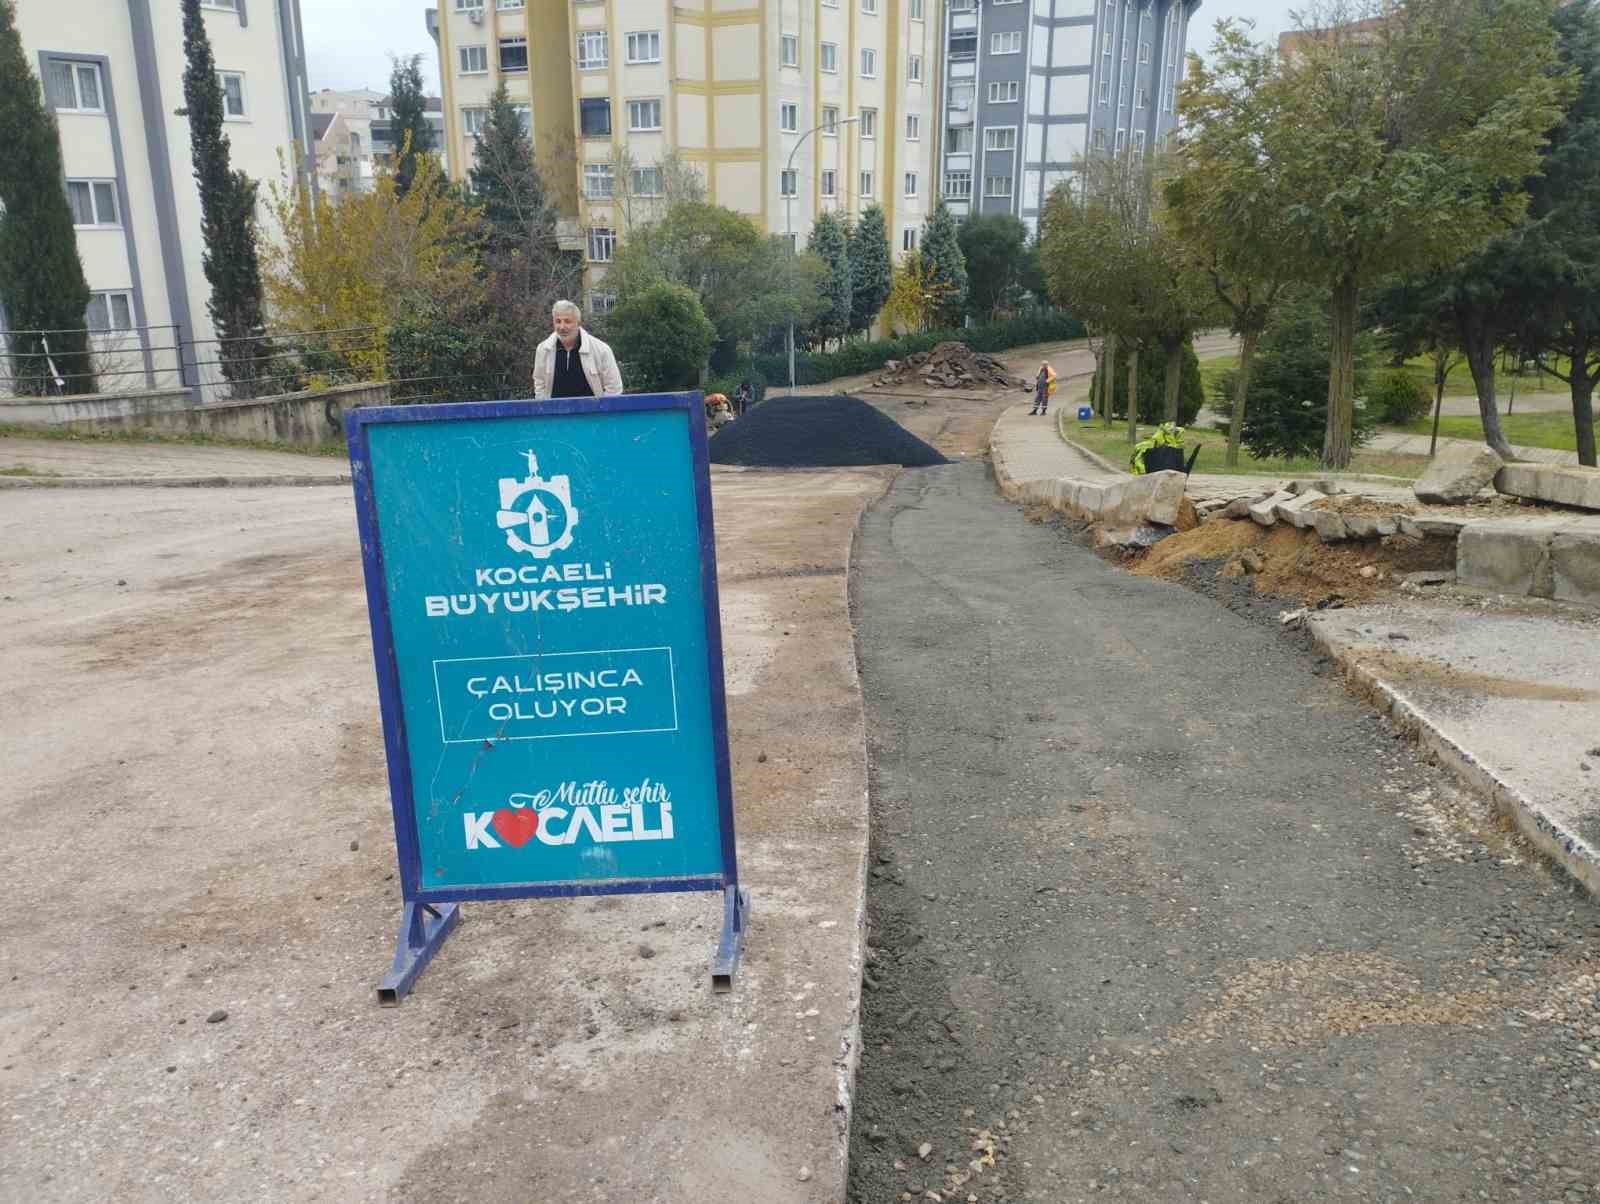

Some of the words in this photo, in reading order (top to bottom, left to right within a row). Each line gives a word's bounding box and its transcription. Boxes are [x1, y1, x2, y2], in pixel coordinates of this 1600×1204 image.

[466, 669, 643, 700] ÇALIŞINCA
[488, 697, 627, 721] OLUYOR
[509, 780, 619, 810] Mutlu
[622, 777, 672, 809] şehir
